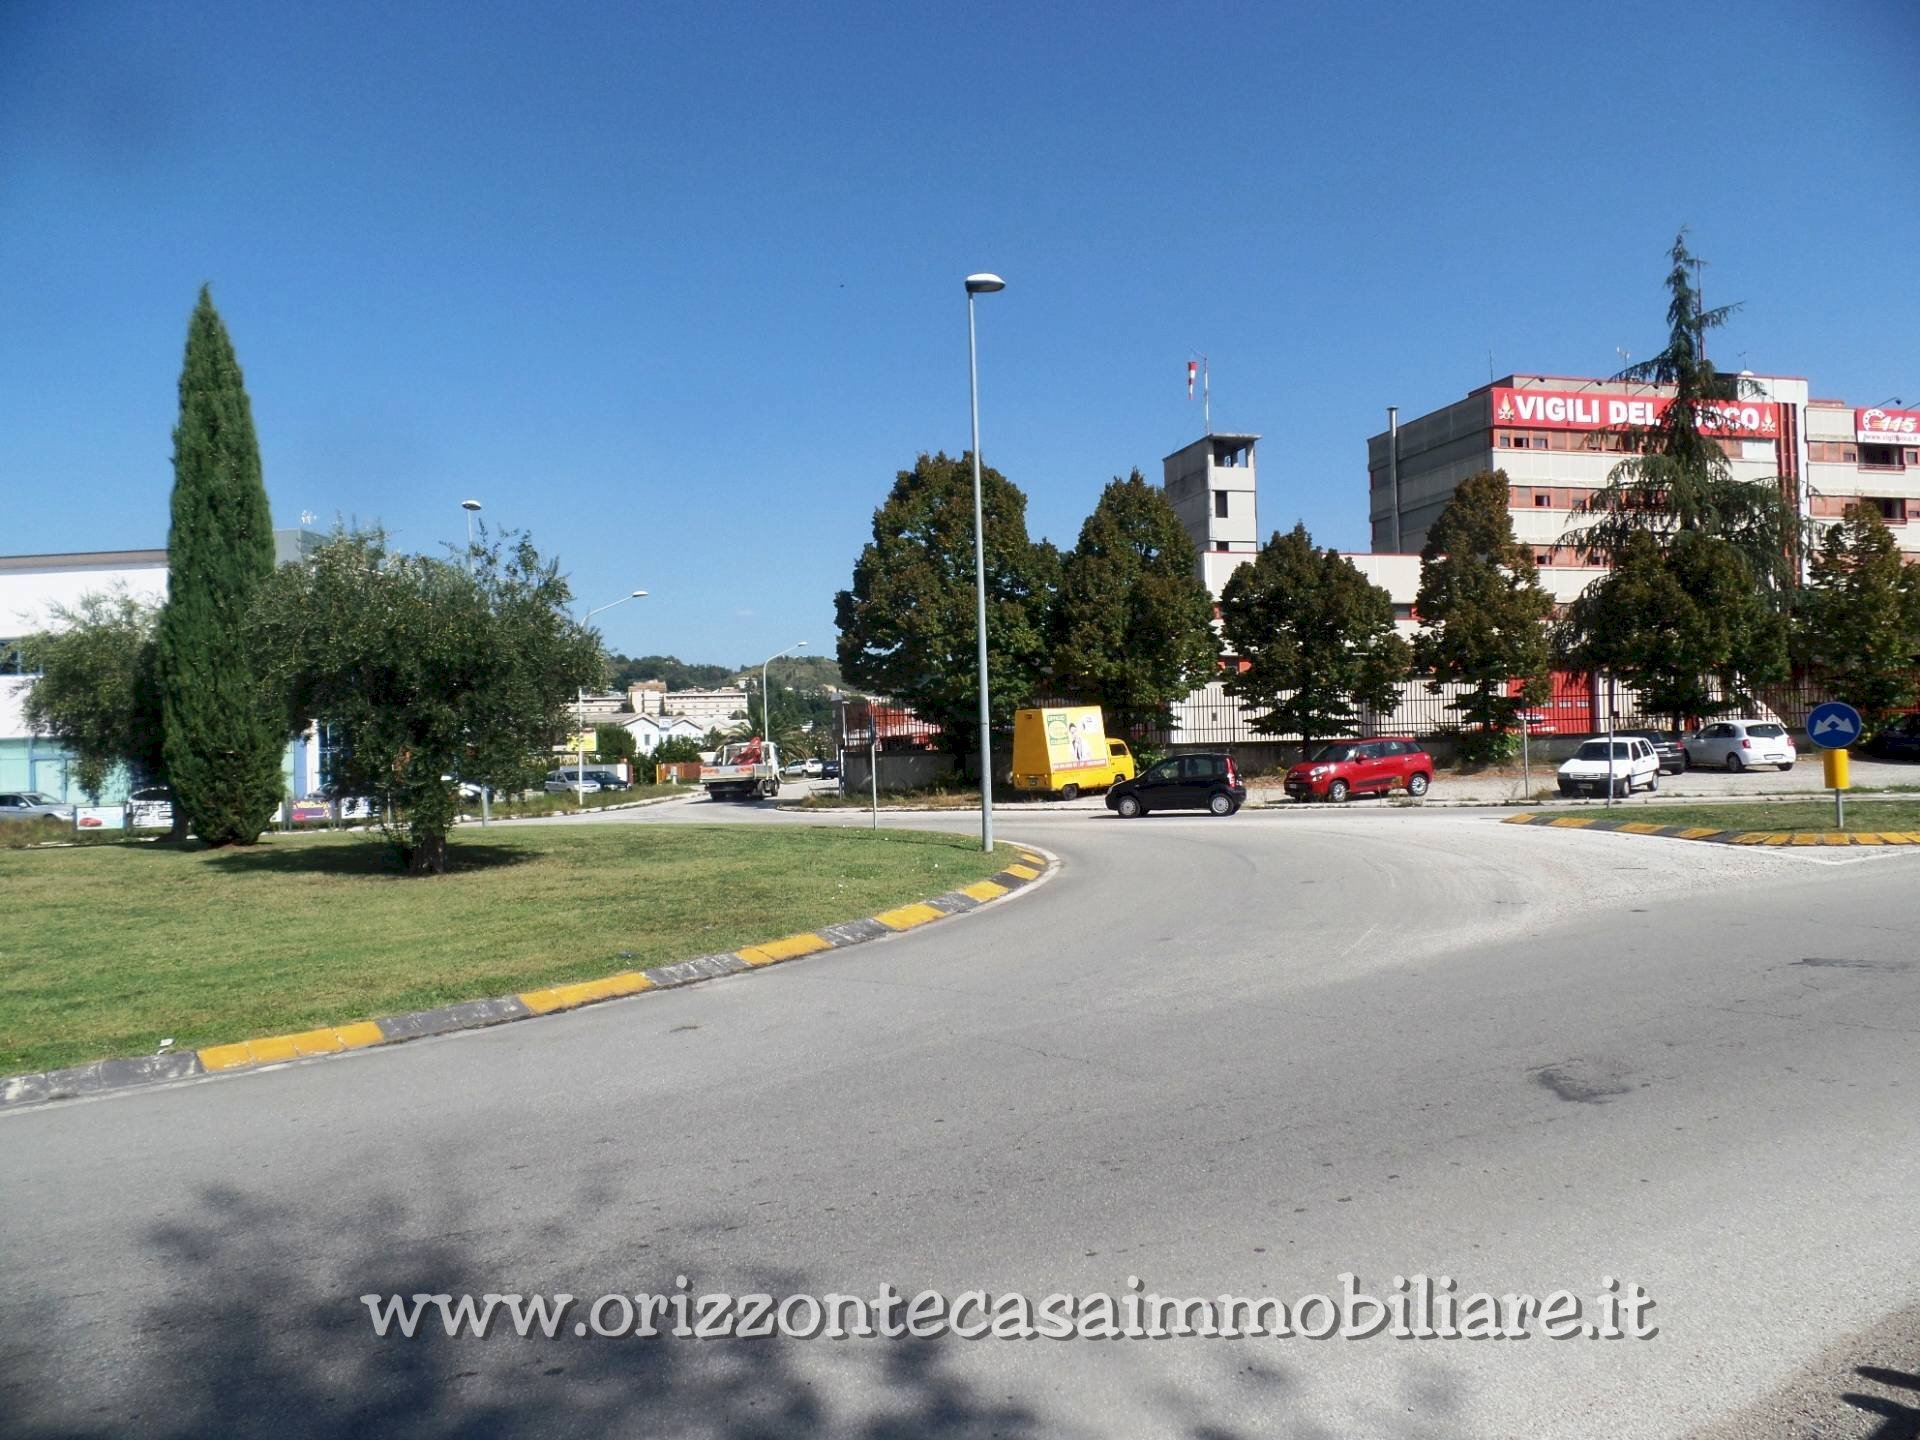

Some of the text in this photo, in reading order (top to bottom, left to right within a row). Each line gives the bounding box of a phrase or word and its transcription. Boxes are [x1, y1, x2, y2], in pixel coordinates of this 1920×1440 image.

[1514, 395, 1600, 423] VIGILI
[1609, 400, 1661, 426] DEL
[1881, 415, 1918, 433] 115
